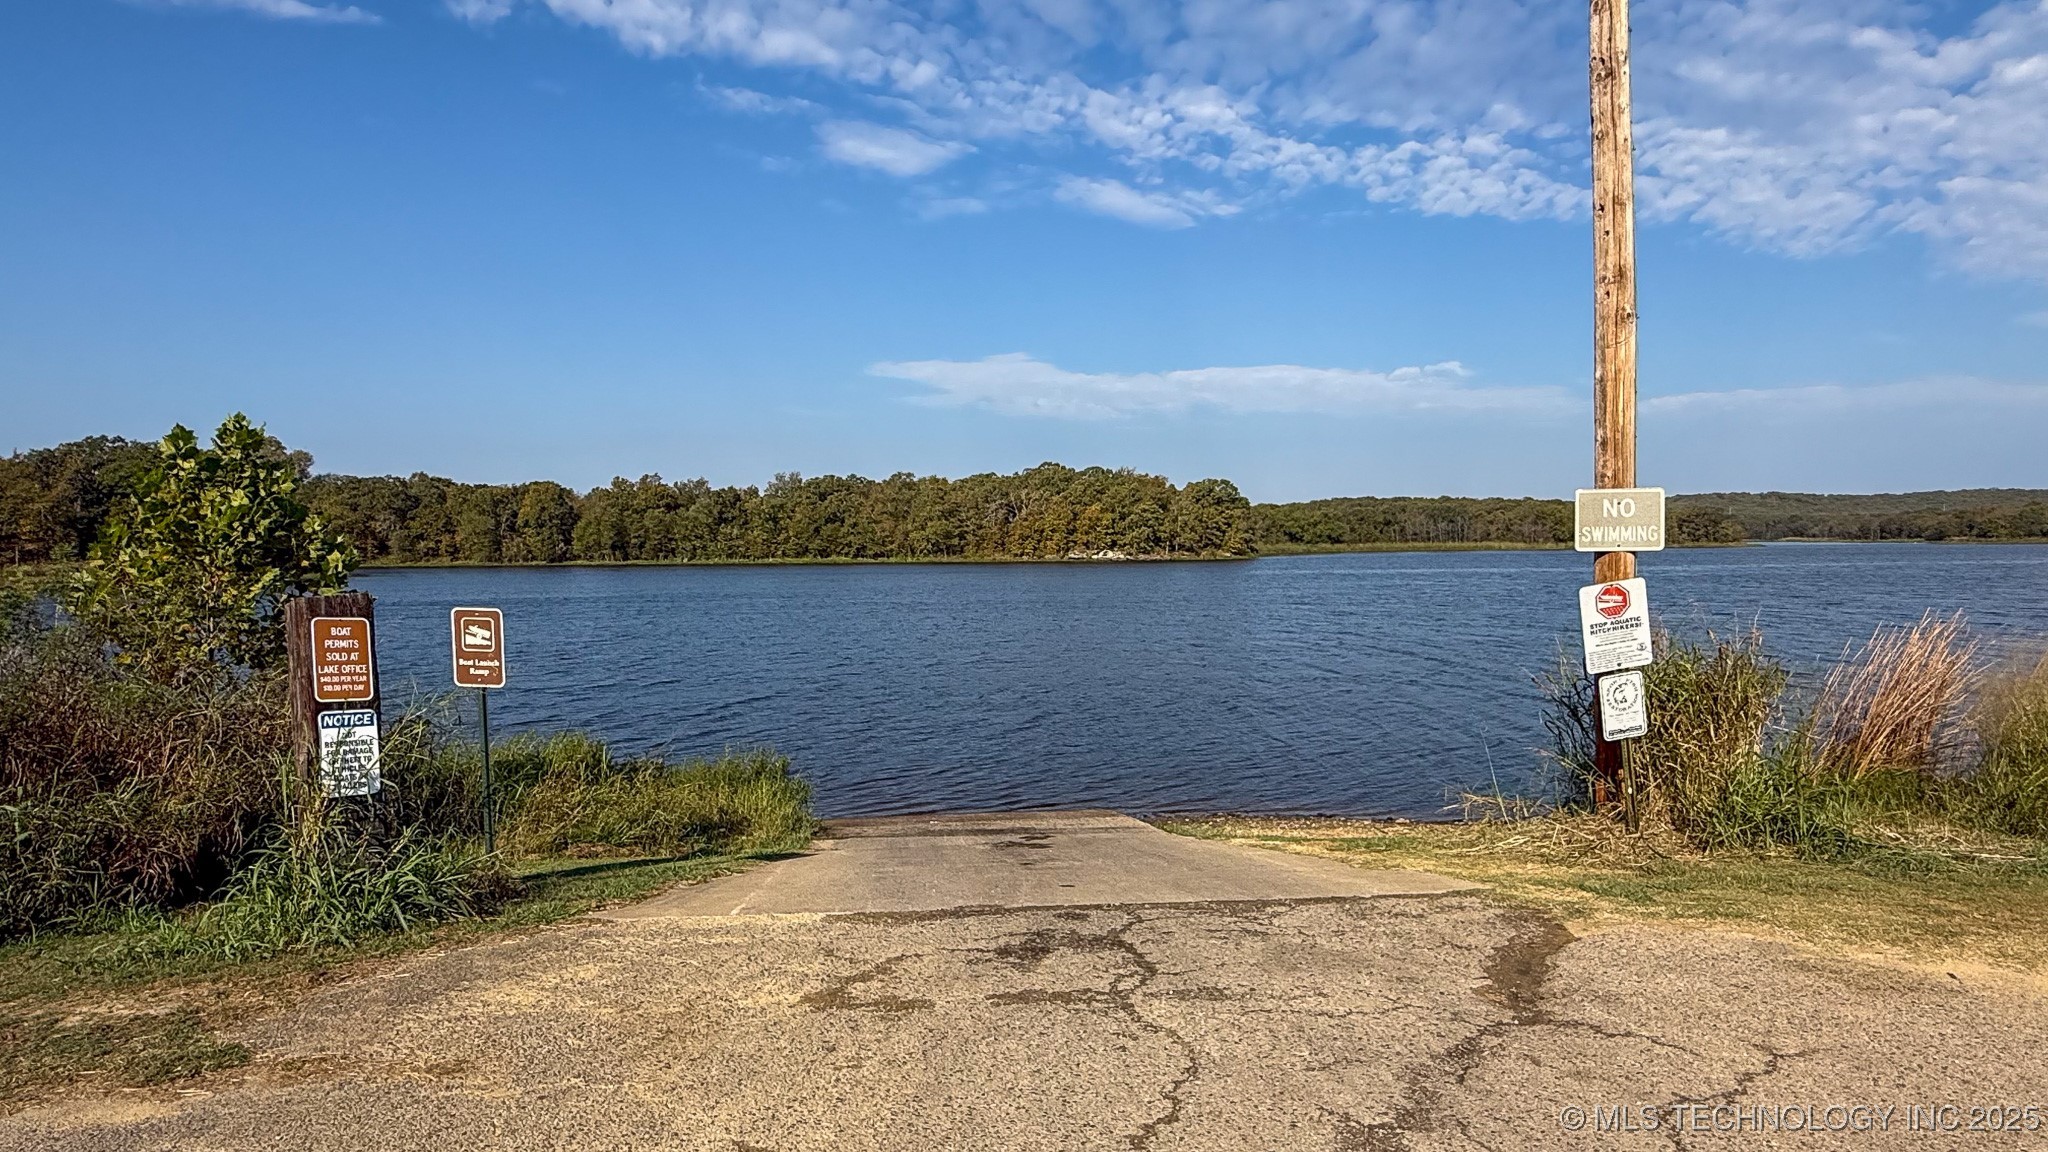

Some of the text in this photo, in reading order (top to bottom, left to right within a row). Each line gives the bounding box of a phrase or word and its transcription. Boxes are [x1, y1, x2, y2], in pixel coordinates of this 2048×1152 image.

[1602, 498, 1636, 518] NO
[1581, 525, 1659, 542] SWIMMING
[1589, 616, 1642, 630] STOP AQUATIC
[330, 627, 352, 636] BOAT
[324, 640, 359, 649] PERMITS
[326, 652, 360, 661] SOLD AT
[475, 658, 500, 667] Launch
[318, 665, 368, 674] LAKE OFFICE
[469, 667, 490, 677] Ramp
[323, 713, 372, 727] NOTICE
